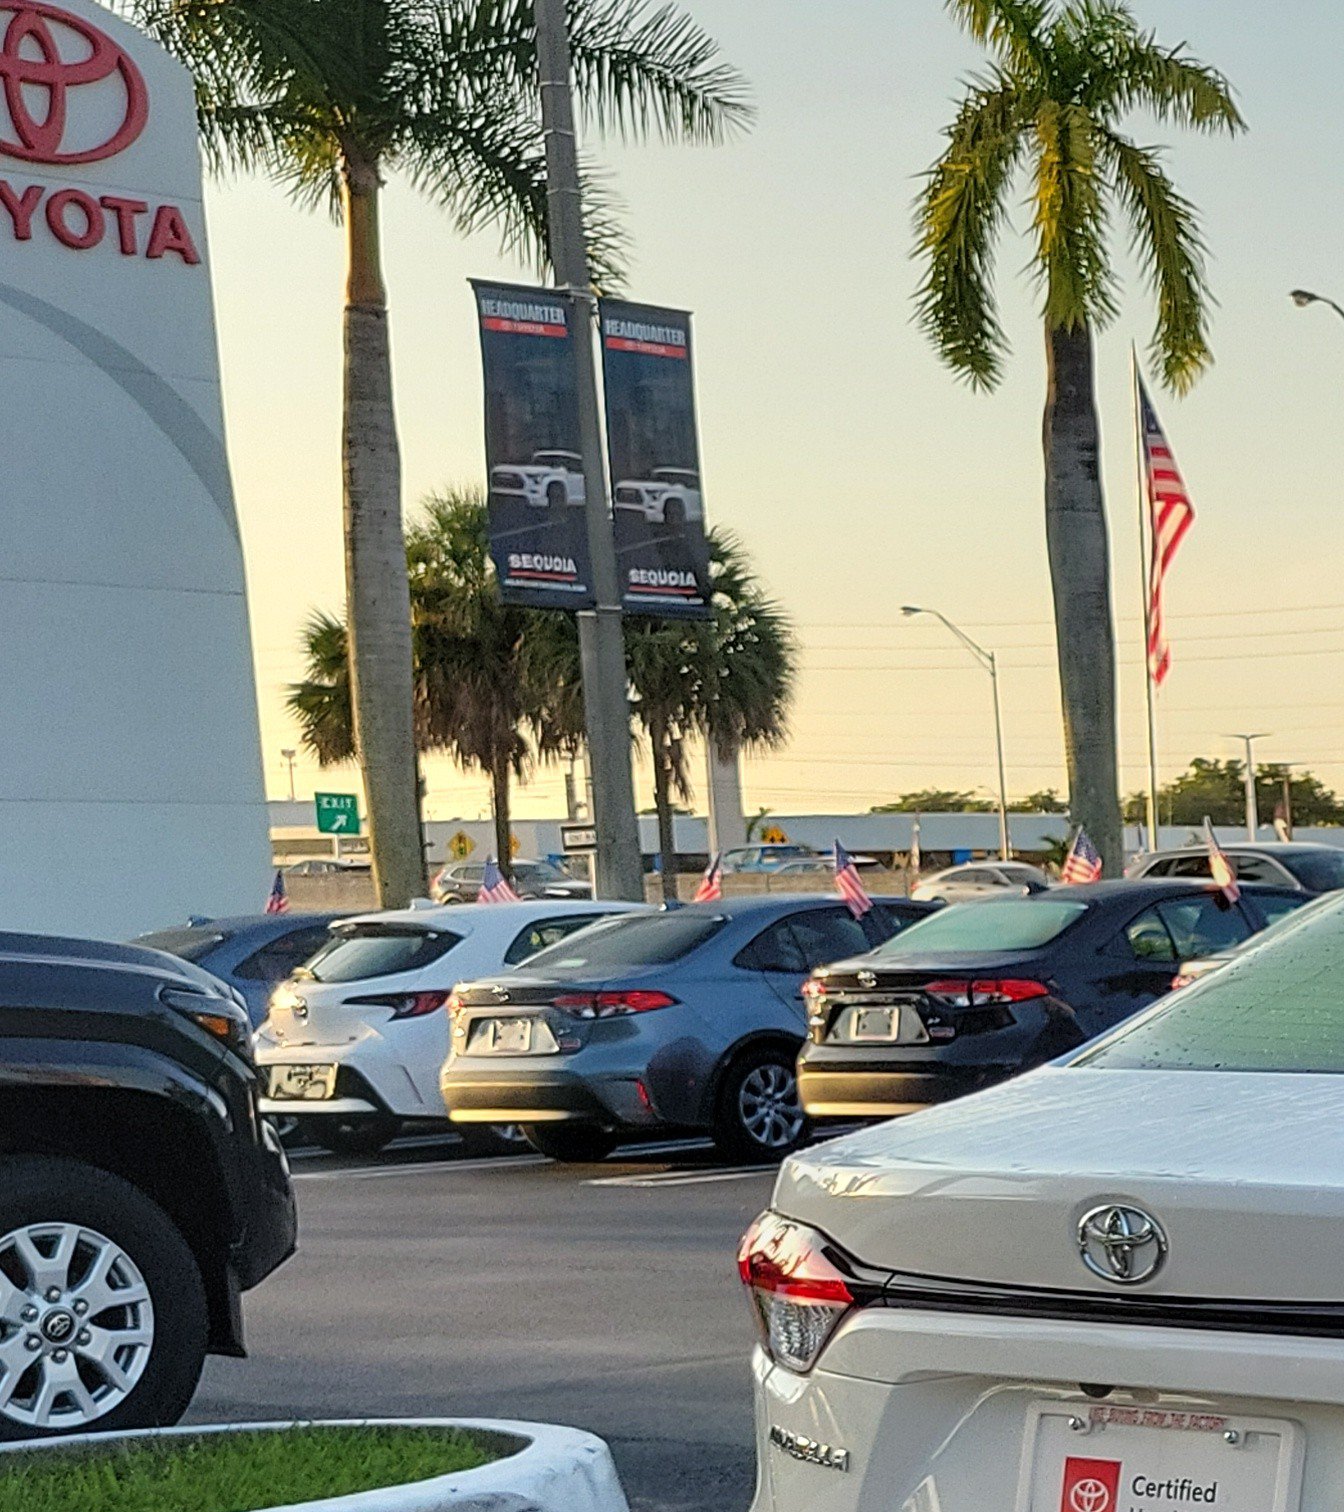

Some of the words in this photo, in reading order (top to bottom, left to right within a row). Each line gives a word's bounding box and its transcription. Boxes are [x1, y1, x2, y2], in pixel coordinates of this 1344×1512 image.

[481, 299, 567, 325] HEADQUARTER
[605, 319, 686, 346] HEADQUARTER
[508, 553, 577, 573] SEQUOIA
[629, 568, 697, 587] SEQUOIA
[321, 797, 352, 809] EXIT
[1132, 1476, 1217, 1503] Certified
